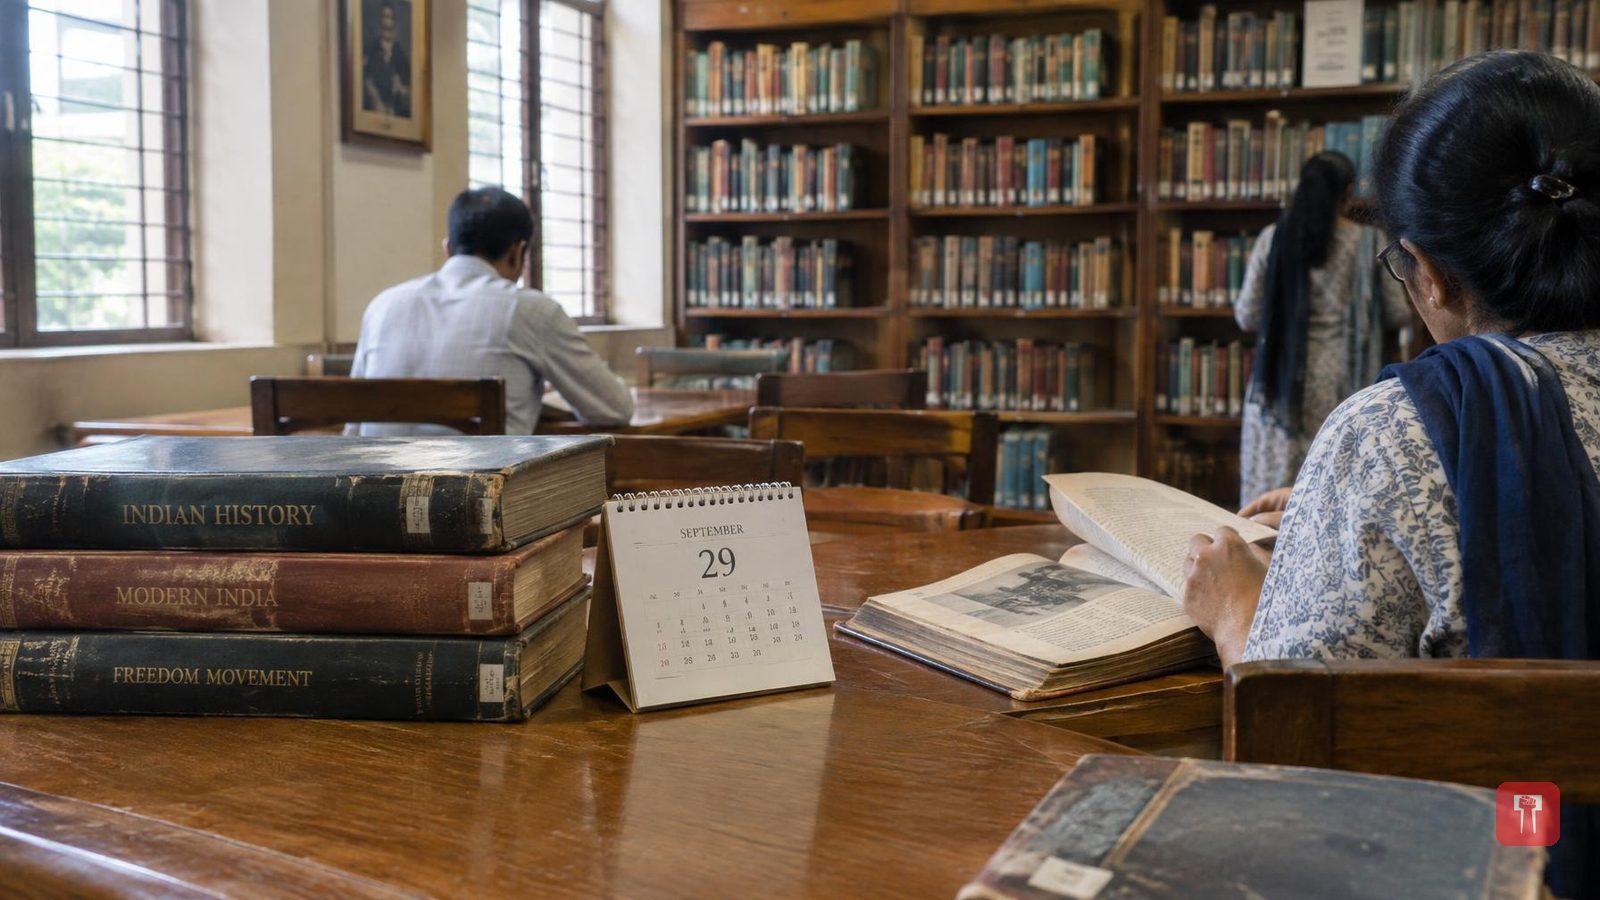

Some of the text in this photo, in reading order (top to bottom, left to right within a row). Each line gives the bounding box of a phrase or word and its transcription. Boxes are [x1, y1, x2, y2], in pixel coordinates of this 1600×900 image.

[122, 504, 317, 526] INDIAN HISTORY
[680, 523, 744, 539] SEPTEMBER
[698, 547, 736, 579] 29
[116, 586, 279, 607] MODERN INDIA
[113, 667, 313, 687] FREEDOM MOVEMENT
